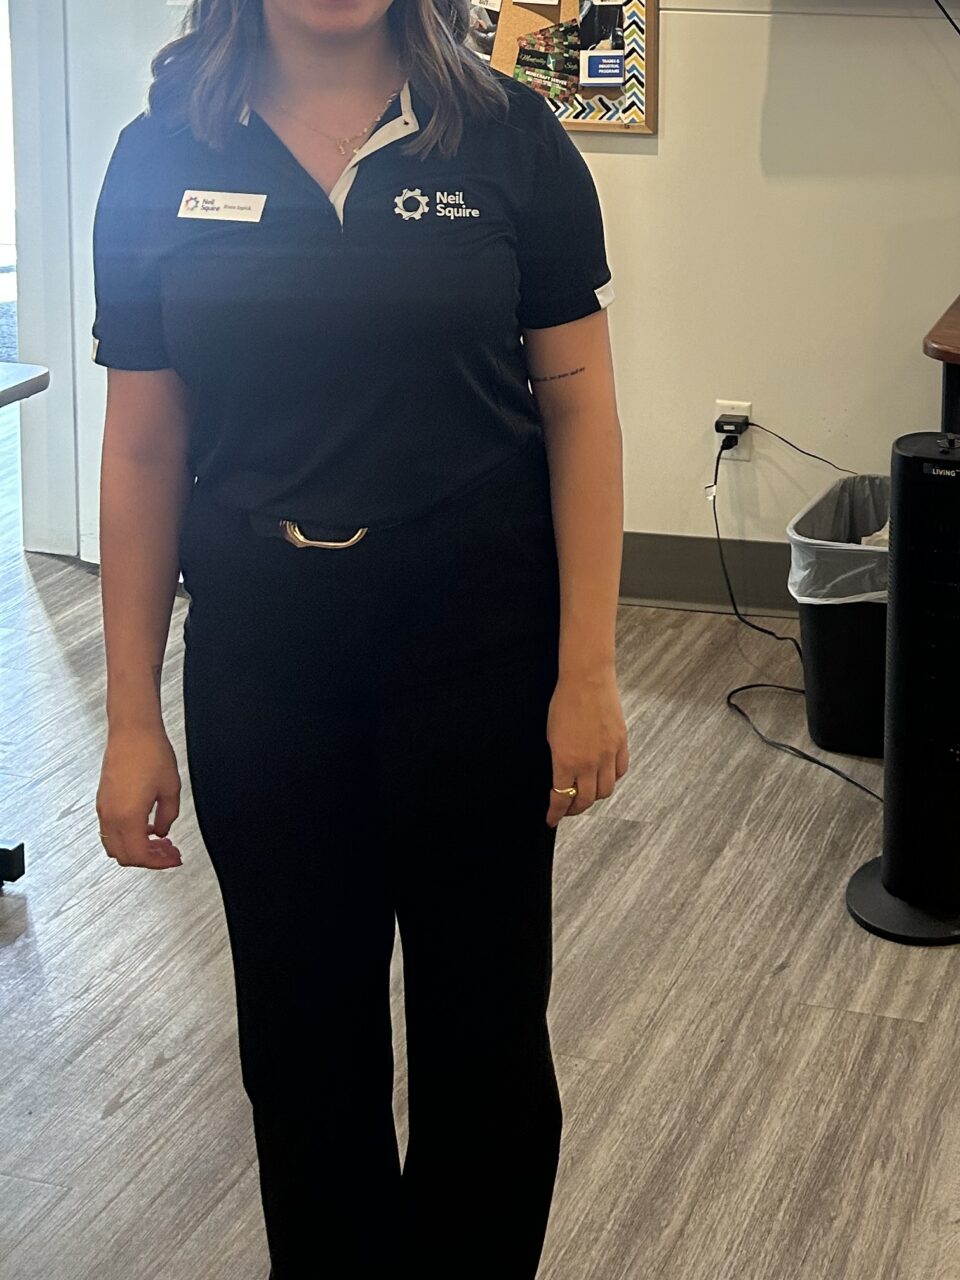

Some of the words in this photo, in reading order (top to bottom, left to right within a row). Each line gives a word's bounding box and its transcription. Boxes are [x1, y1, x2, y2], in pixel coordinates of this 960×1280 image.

[436, 191, 464, 204] Neil
[436, 204, 480, 220] Squire
[932, 468, 956, 477] LIVING
